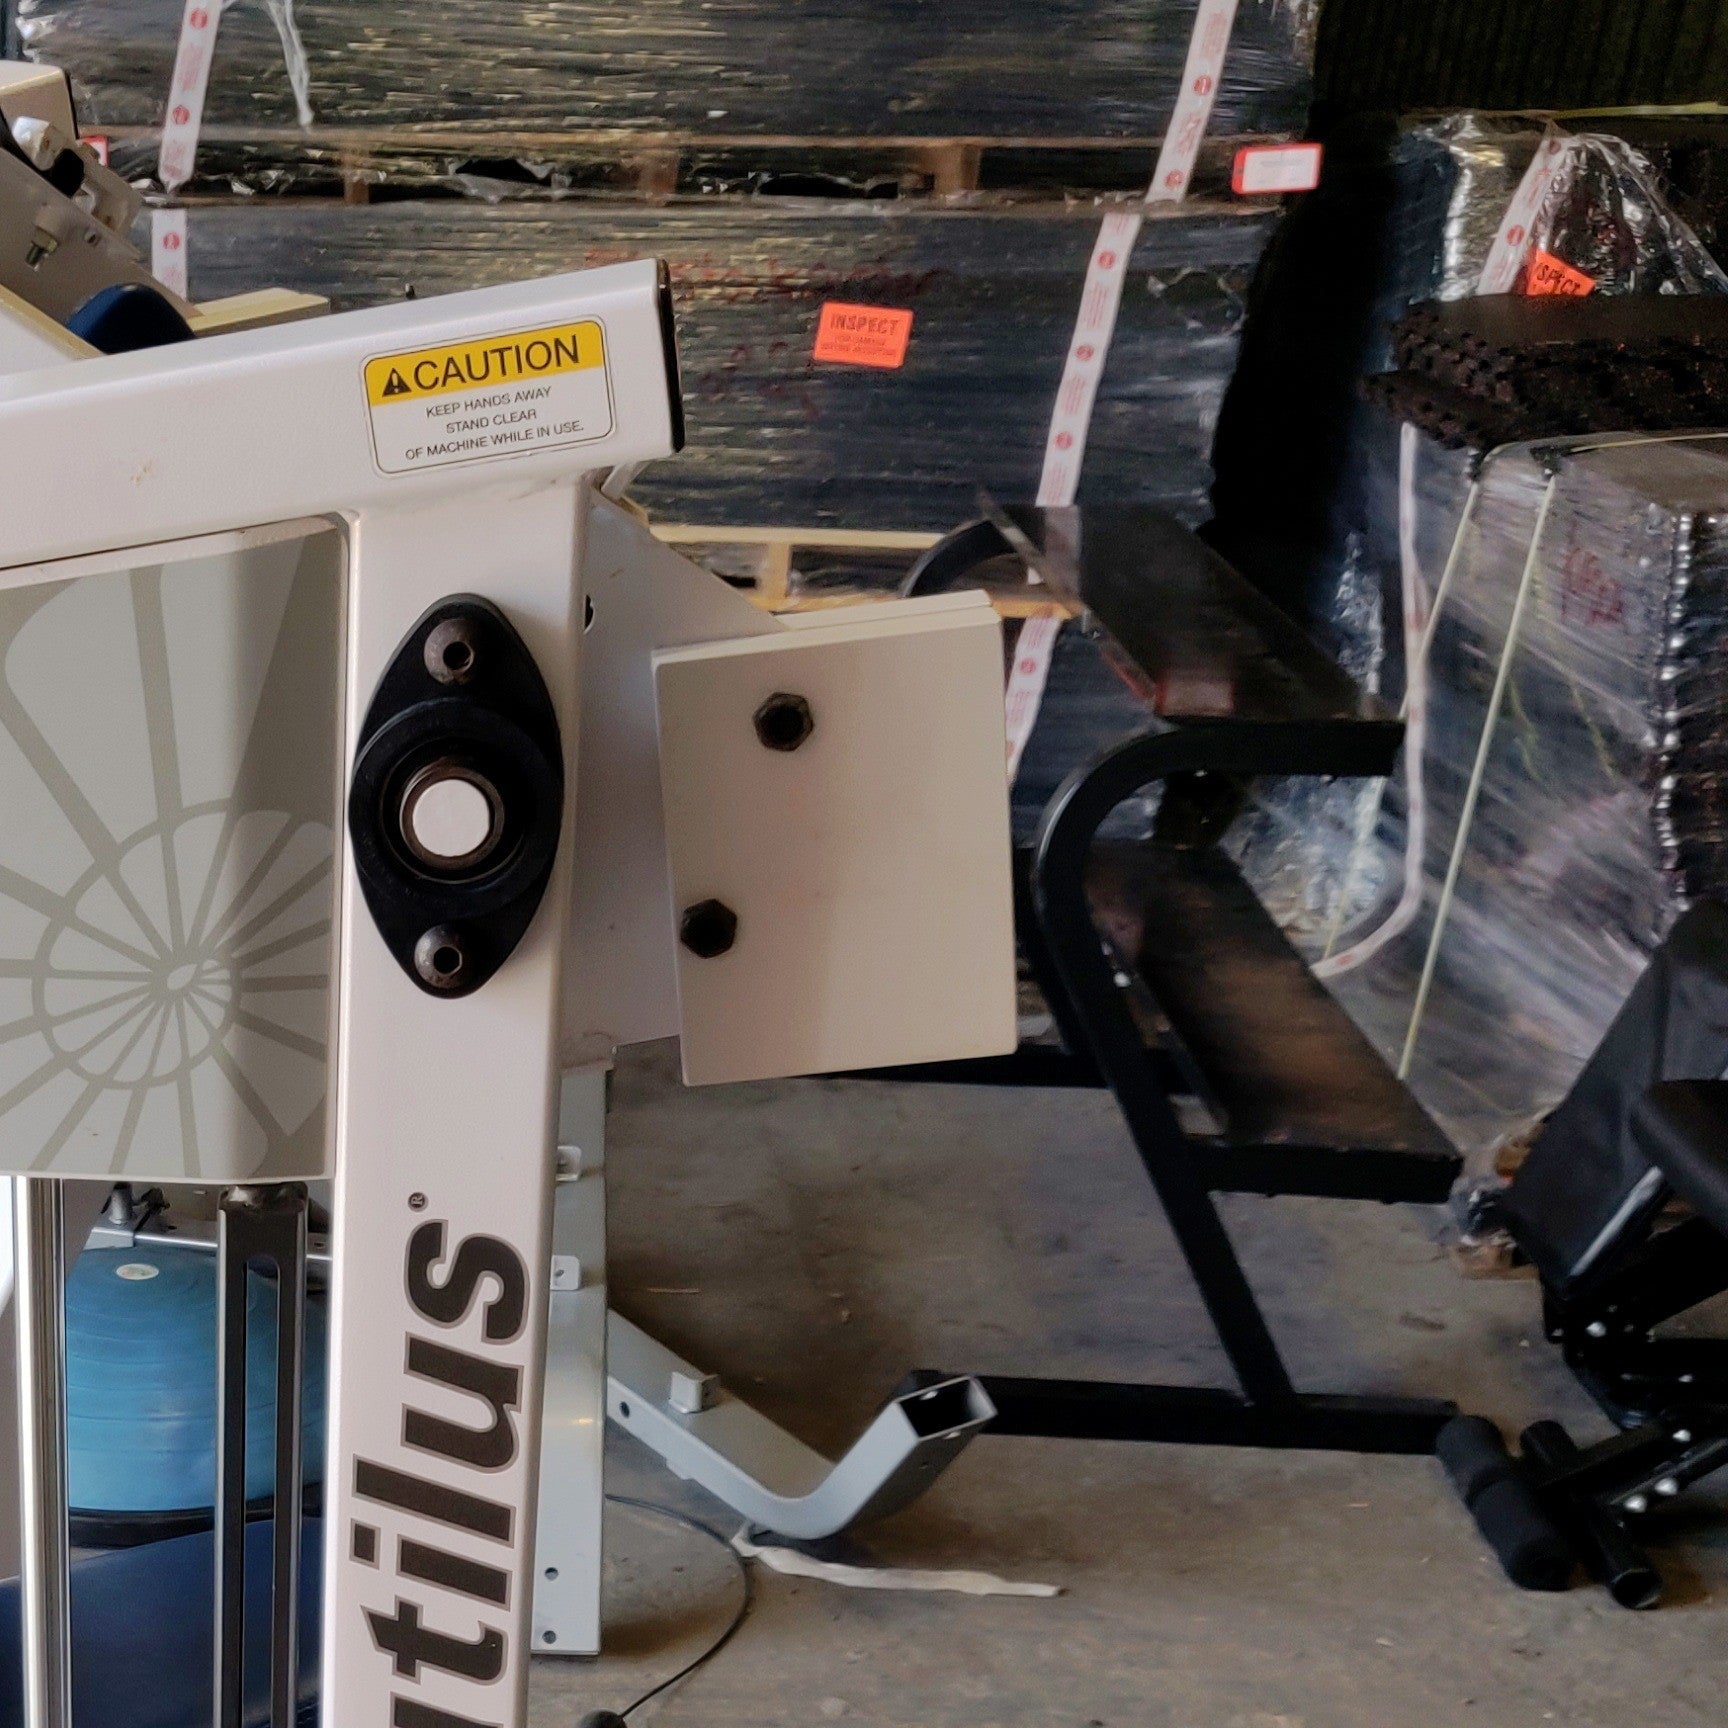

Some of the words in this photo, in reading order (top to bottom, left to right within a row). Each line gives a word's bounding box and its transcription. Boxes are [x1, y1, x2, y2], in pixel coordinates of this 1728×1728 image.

[830, 313, 900, 335] INSPECT
[413, 334, 580, 391] CAUTION
[426, 402, 461, 418] KEEP
[464, 393, 511, 412] HANDS
[514, 386, 552, 403] AWAY
[446, 416, 489, 434] STAND
[492, 409, 537, 426] CLEAR
[405, 448, 423, 460] OF
[427, 436, 488, 457] MACHINE
[491, 428, 534, 446] WHILE
[537, 427, 550, 438] IN
[553, 420, 584, 435] USE.
